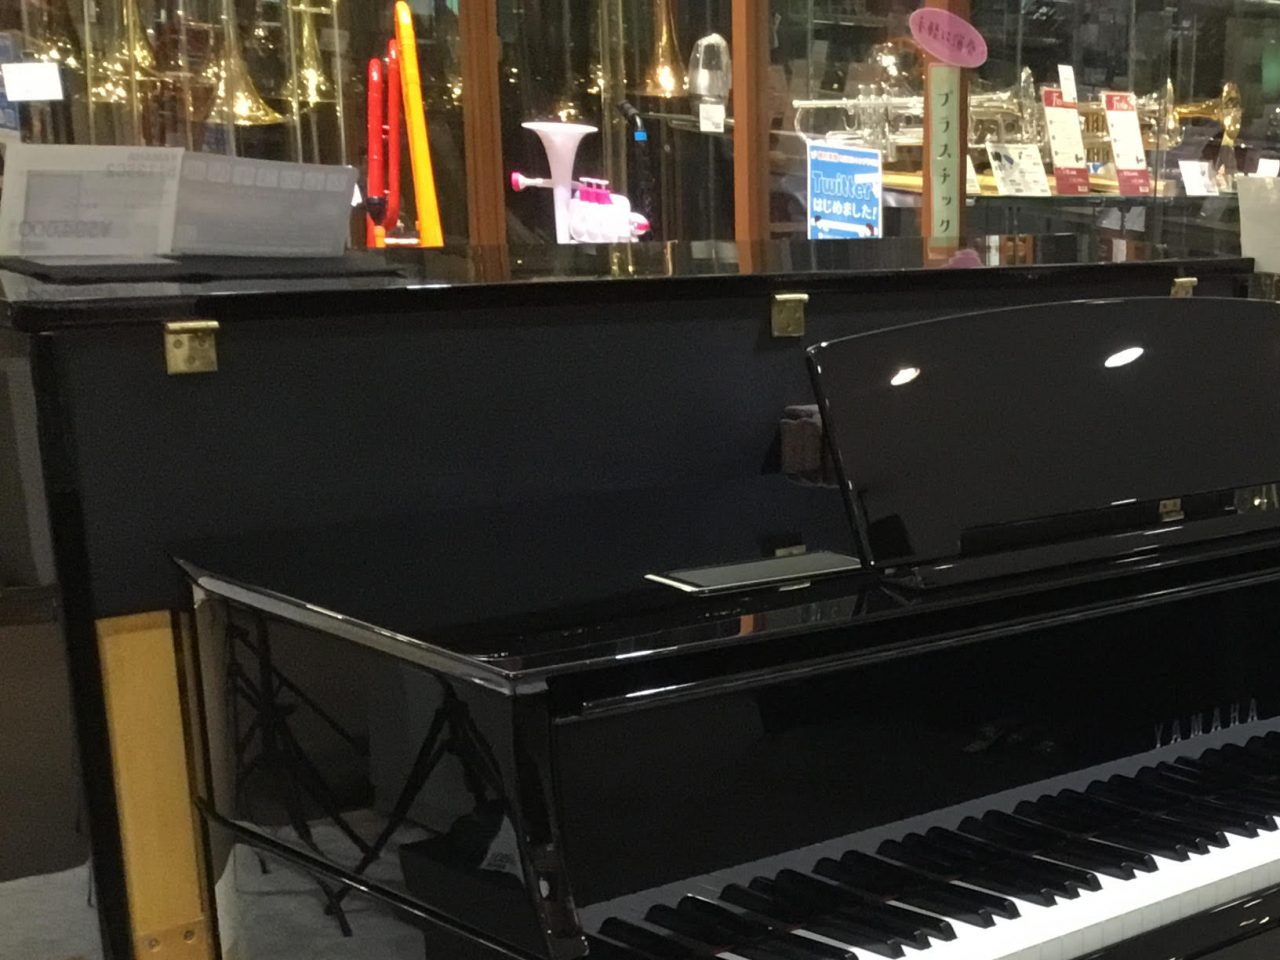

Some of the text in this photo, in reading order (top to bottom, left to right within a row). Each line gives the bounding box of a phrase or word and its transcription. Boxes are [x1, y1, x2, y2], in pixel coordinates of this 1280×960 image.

[936, 91, 954, 233] プラスチック
[811, 171, 872, 201] Twitter
[812, 197, 878, 220] はじめました!
[1154, 697, 1258, 749] YAMAHA
